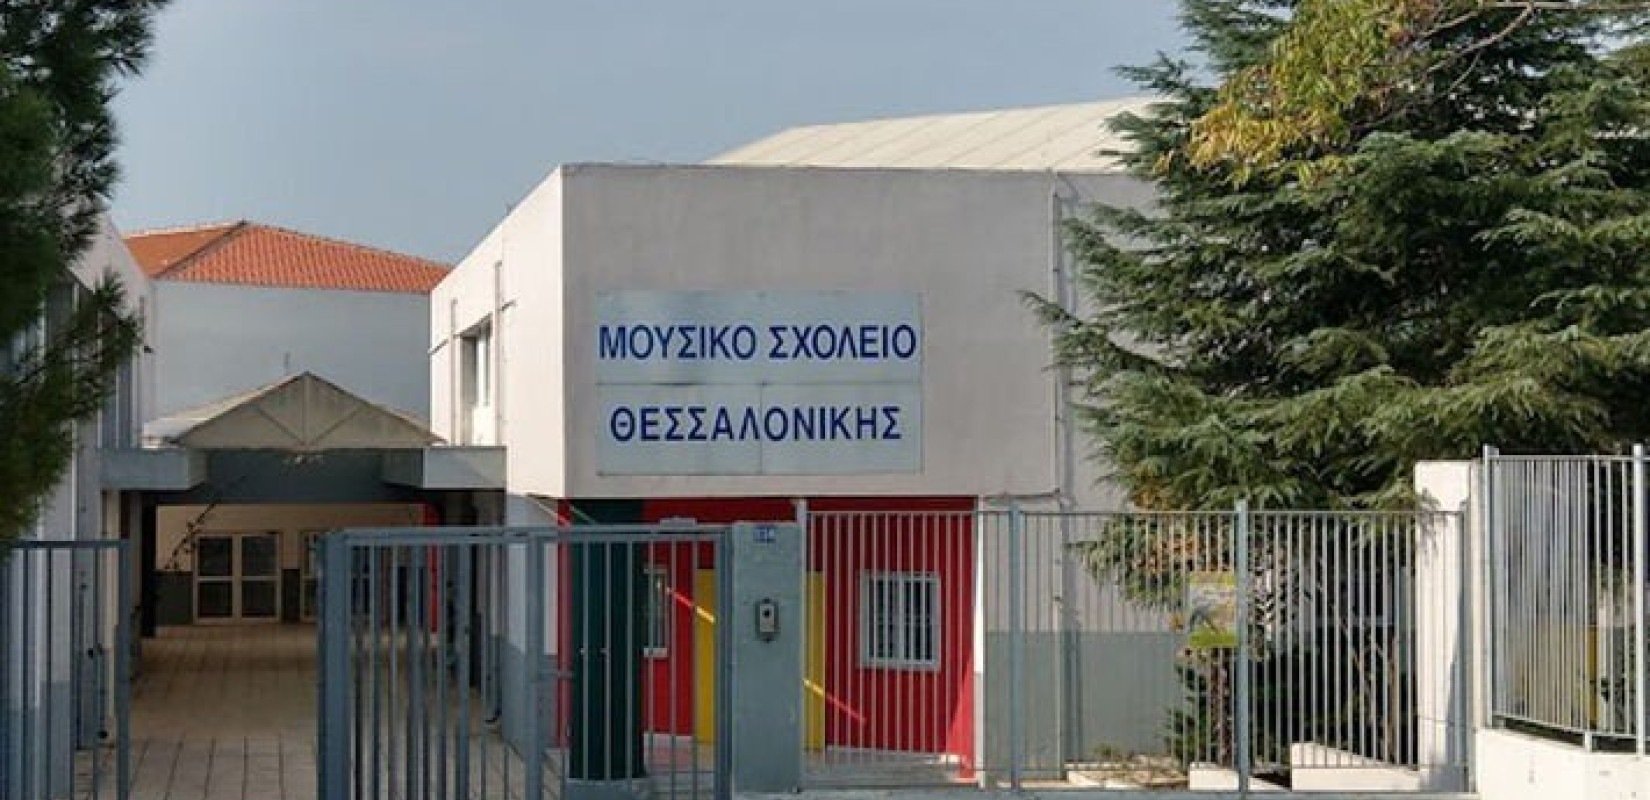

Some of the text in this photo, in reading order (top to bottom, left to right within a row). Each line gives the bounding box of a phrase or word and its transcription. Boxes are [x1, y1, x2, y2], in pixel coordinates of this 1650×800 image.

[598, 324, 917, 360] ΜΟΥΣΙΚΟ ΣΧΟΛΕΙΟ
[610, 406, 902, 442] ΘΕΣΣΑΛΟΝΙΚΗΣ
